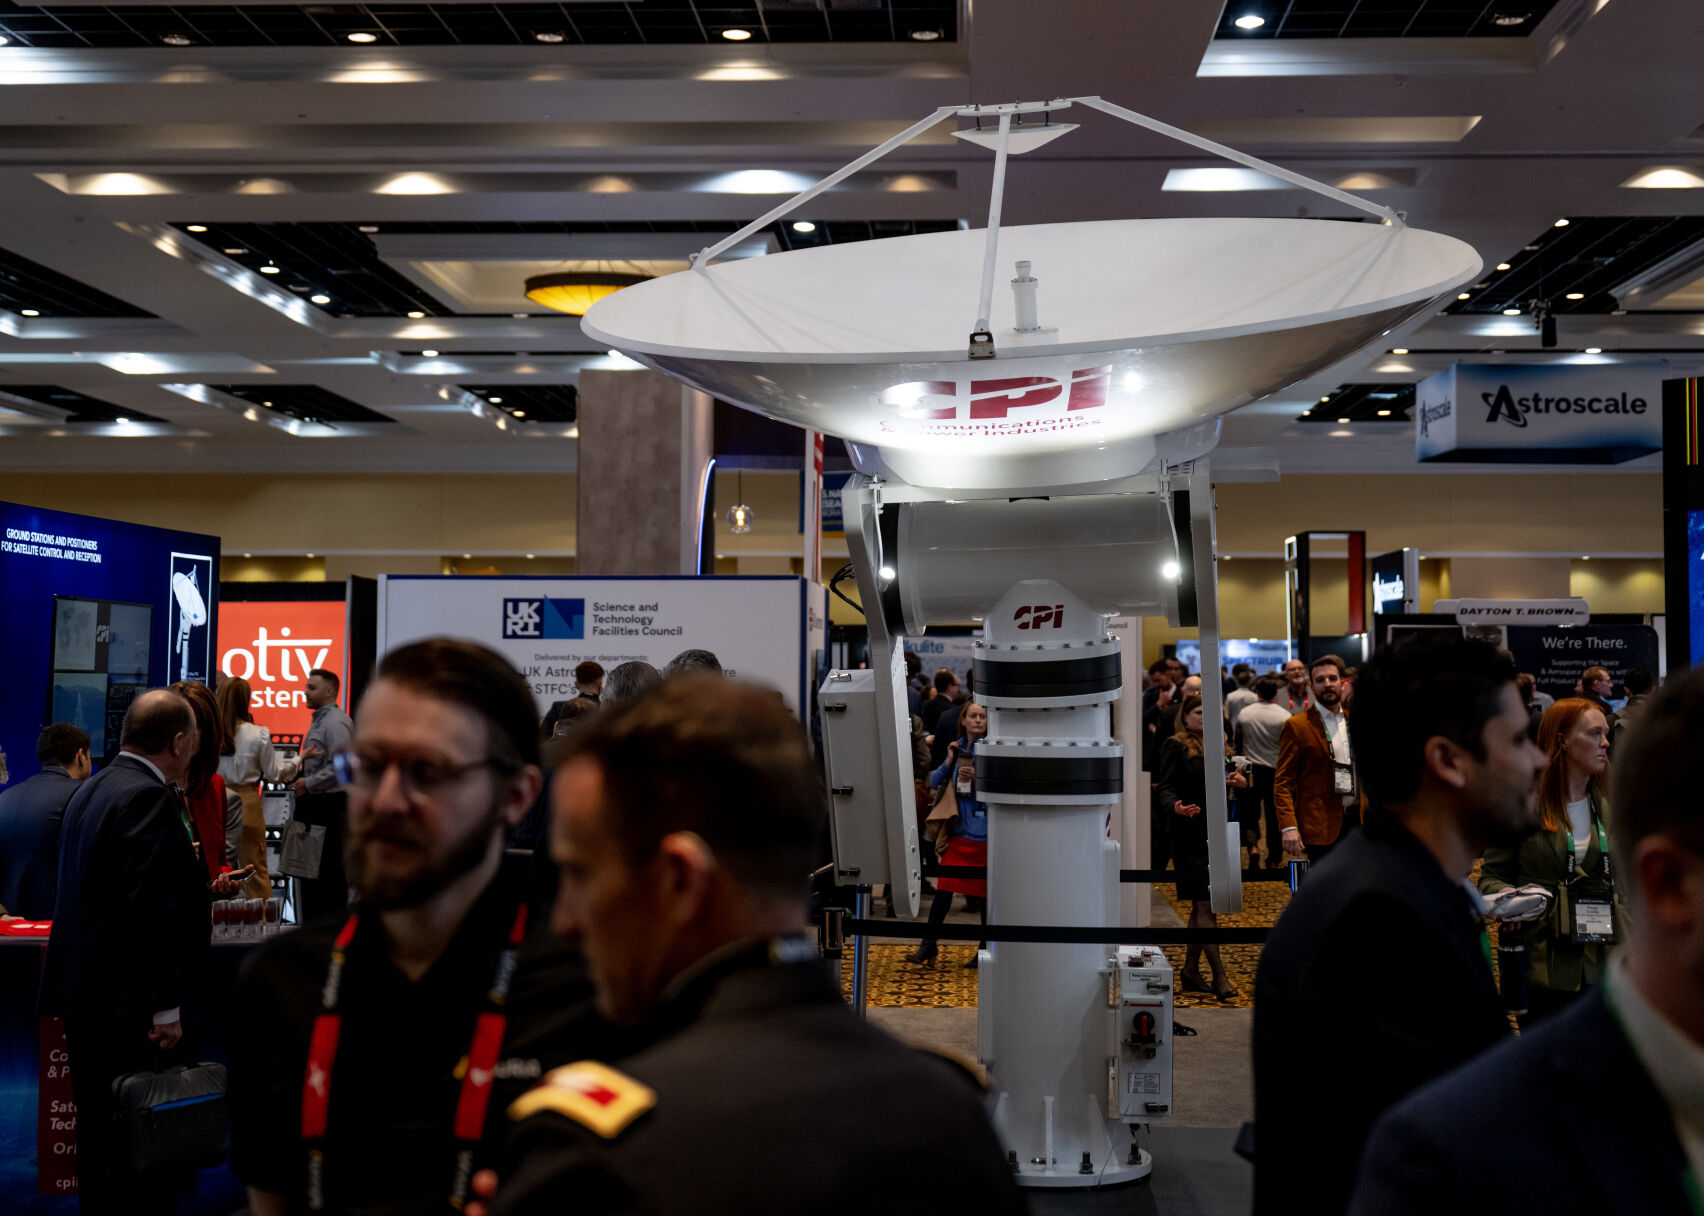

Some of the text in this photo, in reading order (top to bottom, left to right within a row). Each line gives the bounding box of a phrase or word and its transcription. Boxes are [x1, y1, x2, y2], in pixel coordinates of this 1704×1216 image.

[1481, 385, 1647, 427] Astroscale
[6, 528, 98, 551] GROUND STATIONS AND POSITIONERS
[1, 541, 102, 564] FOR SATELLITE CONTROL AND RECEPTION
[593, 602, 659, 612] Science and
[593, 614, 654, 626] Technology
[593, 626, 683, 636] Facilities Council
[1585, 636, 1628, 649] There.
[534, 653, 570, 661] Delivered
[572, 653, 582, 662] by
[598, 653, 649, 662] departments:
[1551, 659, 1587, 668] Supporting
[523, 666, 541, 678] UK
[1547, 668, 1582, 676] Aerospace
[1550, 677, 1576, 685] Product
